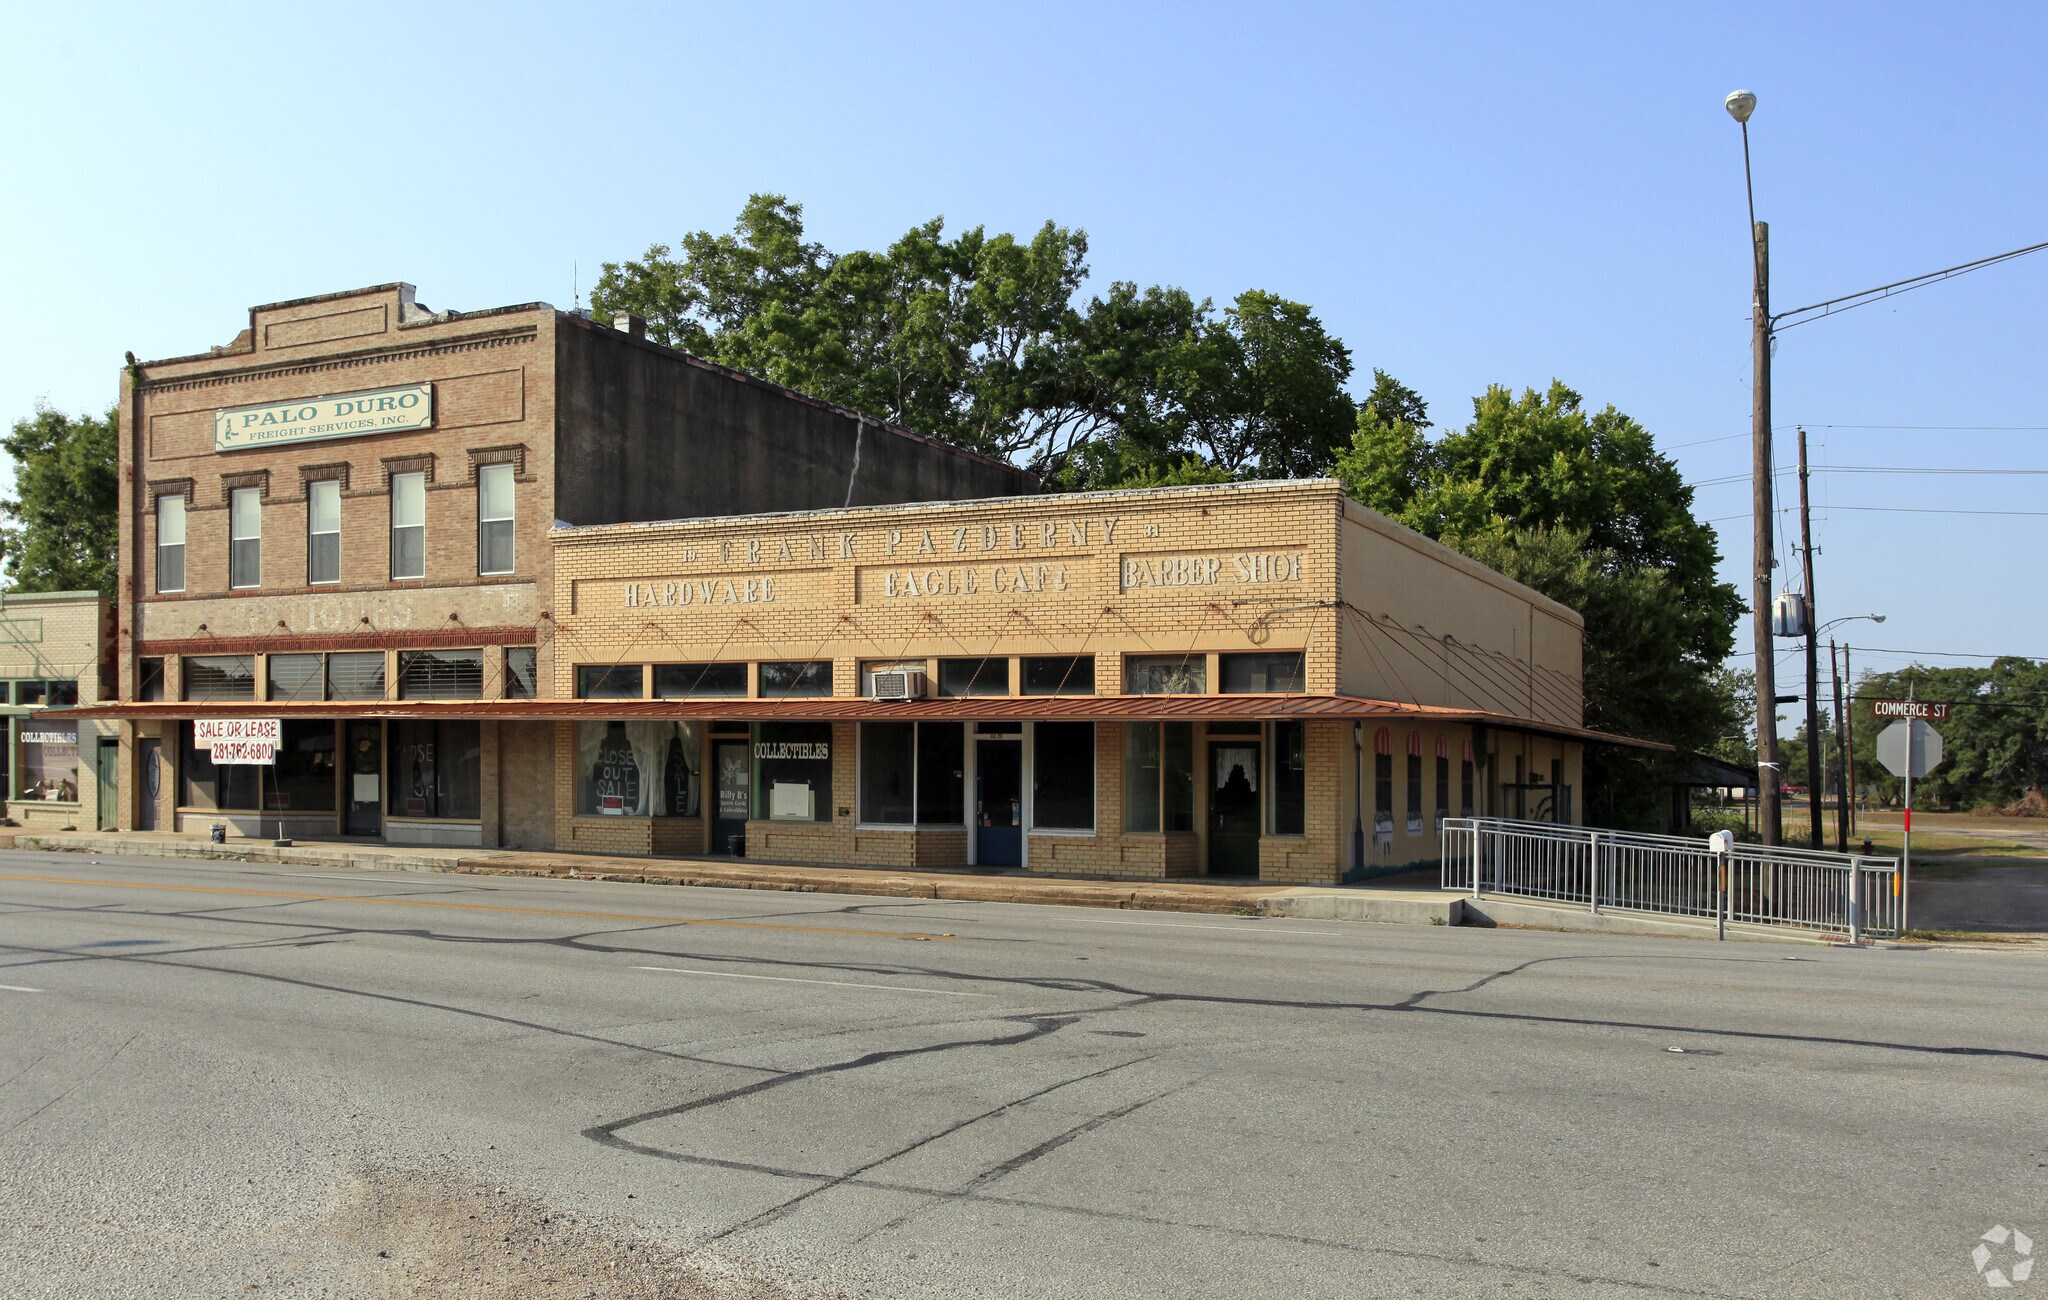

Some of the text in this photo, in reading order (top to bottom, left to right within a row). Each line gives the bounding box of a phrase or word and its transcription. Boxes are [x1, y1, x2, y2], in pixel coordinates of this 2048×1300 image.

[242, 393, 420, 428] PALO DURO
[249, 414, 409, 441] FREIGHT SERVICES, INC.
[719, 532, 857, 565] FRANK
[886, 516, 1119, 557] PAZDERNY
[1143, 523, 1160, 538] 31
[884, 562, 1069, 598] EAGLE CAFE
[1121, 554, 1222, 589] BARBER
[624, 577, 777, 608] HARDWARE
[1875, 702, 1947, 717] COMMERCE ST
[20, 731, 77, 743] COLLECTIBLES
[199, 721, 224, 738] SALE
[227, 721, 242, 738] OR
[245, 721, 277, 739] LEASE
[597, 748, 636, 766] CLOSE
[754, 742, 829, 760] COLLECTIBLES
[603, 766, 633, 782] OUT
[596, 778, 637, 800] SALE
[720, 789, 748, 801] Billy B's
